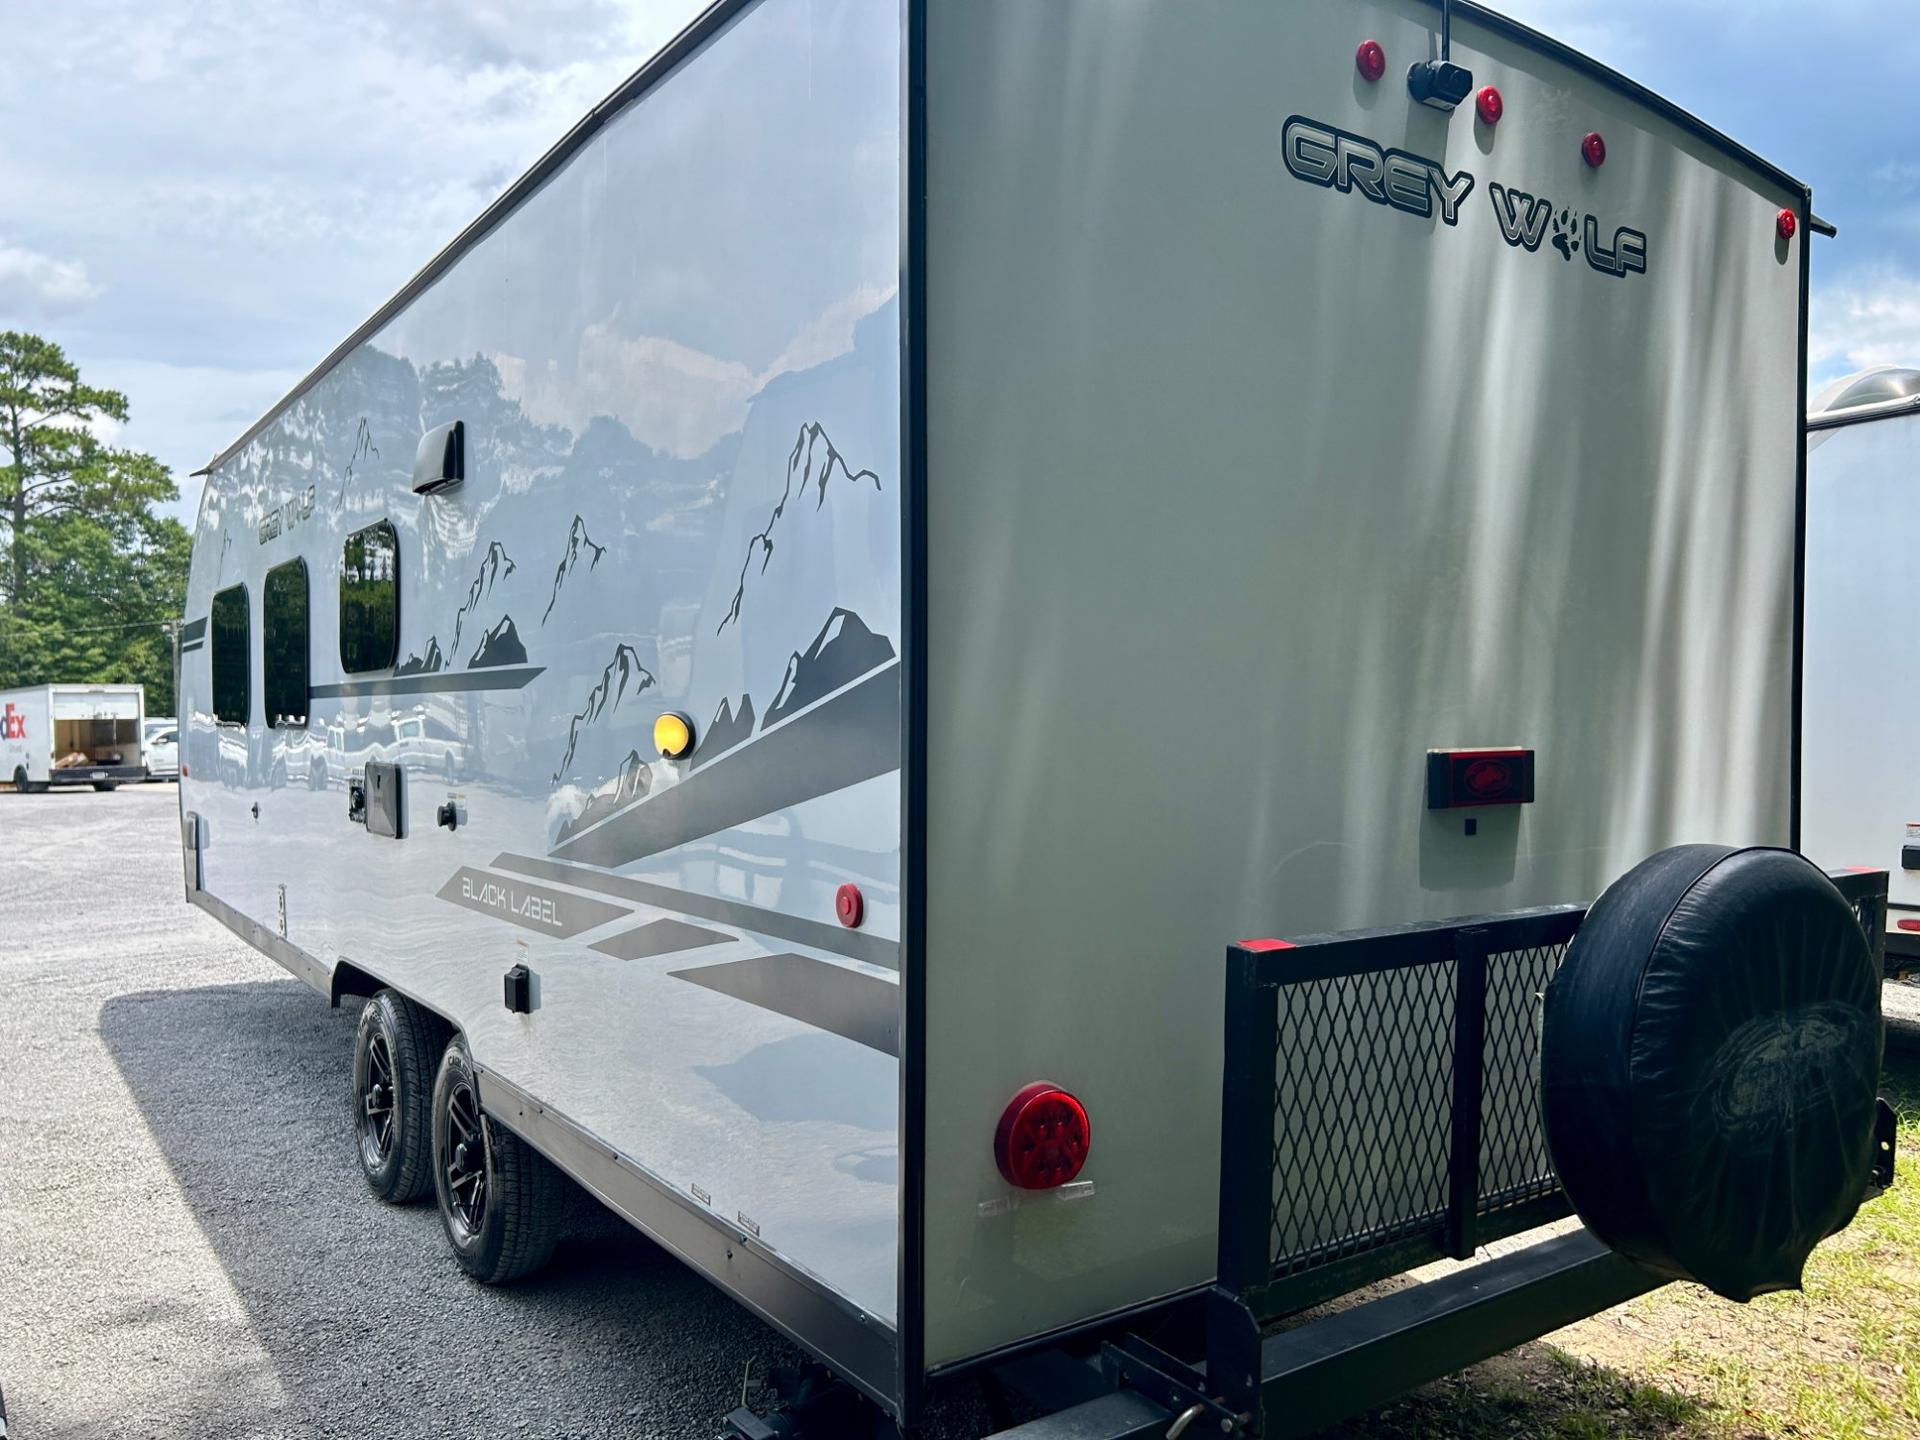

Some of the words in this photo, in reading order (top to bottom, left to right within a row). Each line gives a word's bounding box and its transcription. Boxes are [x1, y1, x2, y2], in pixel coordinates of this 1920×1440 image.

[1281, 114, 1475, 226] GREY
[462, 876, 507, 909] BLACK
[511, 890, 563, 927] LABEL
